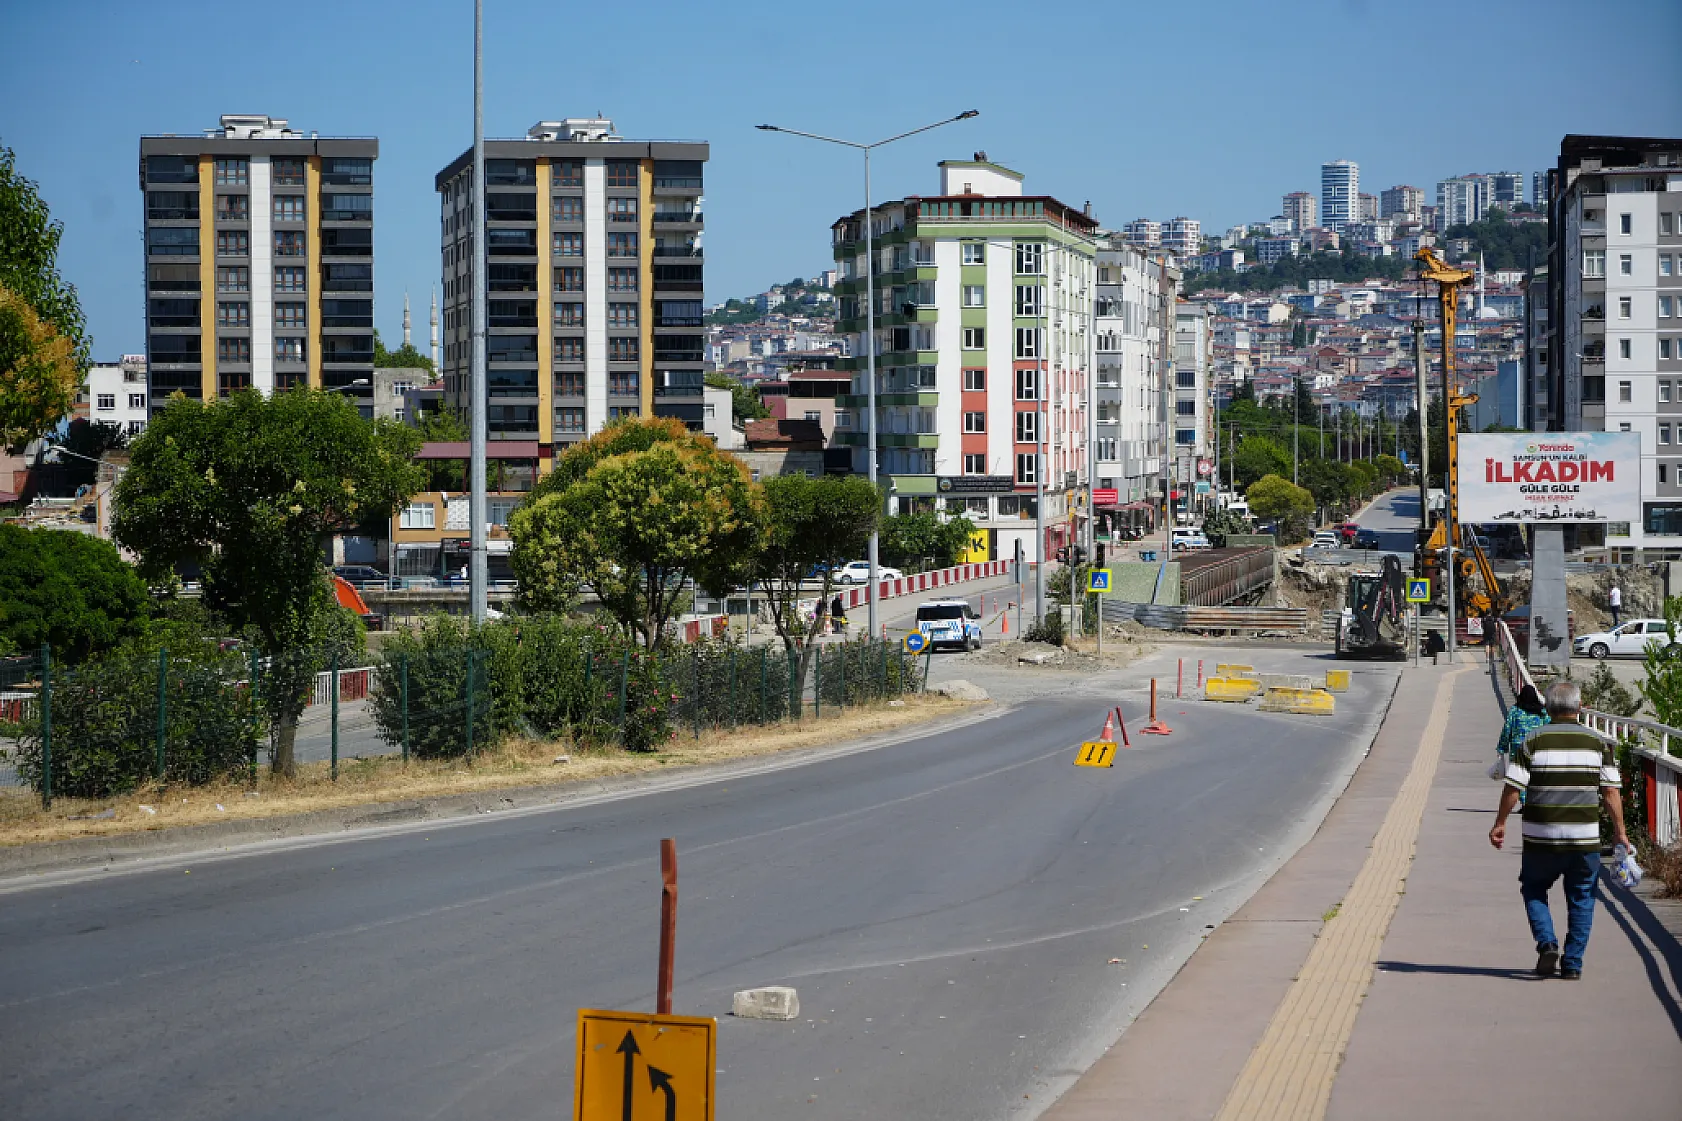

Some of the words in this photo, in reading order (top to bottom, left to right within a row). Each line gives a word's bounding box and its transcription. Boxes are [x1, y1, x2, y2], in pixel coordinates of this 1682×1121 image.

[1485, 458, 1614, 482] İLKADIM
[1519, 483, 1548, 493] GÜLE
[1551, 483, 1580, 493] GÜLE
